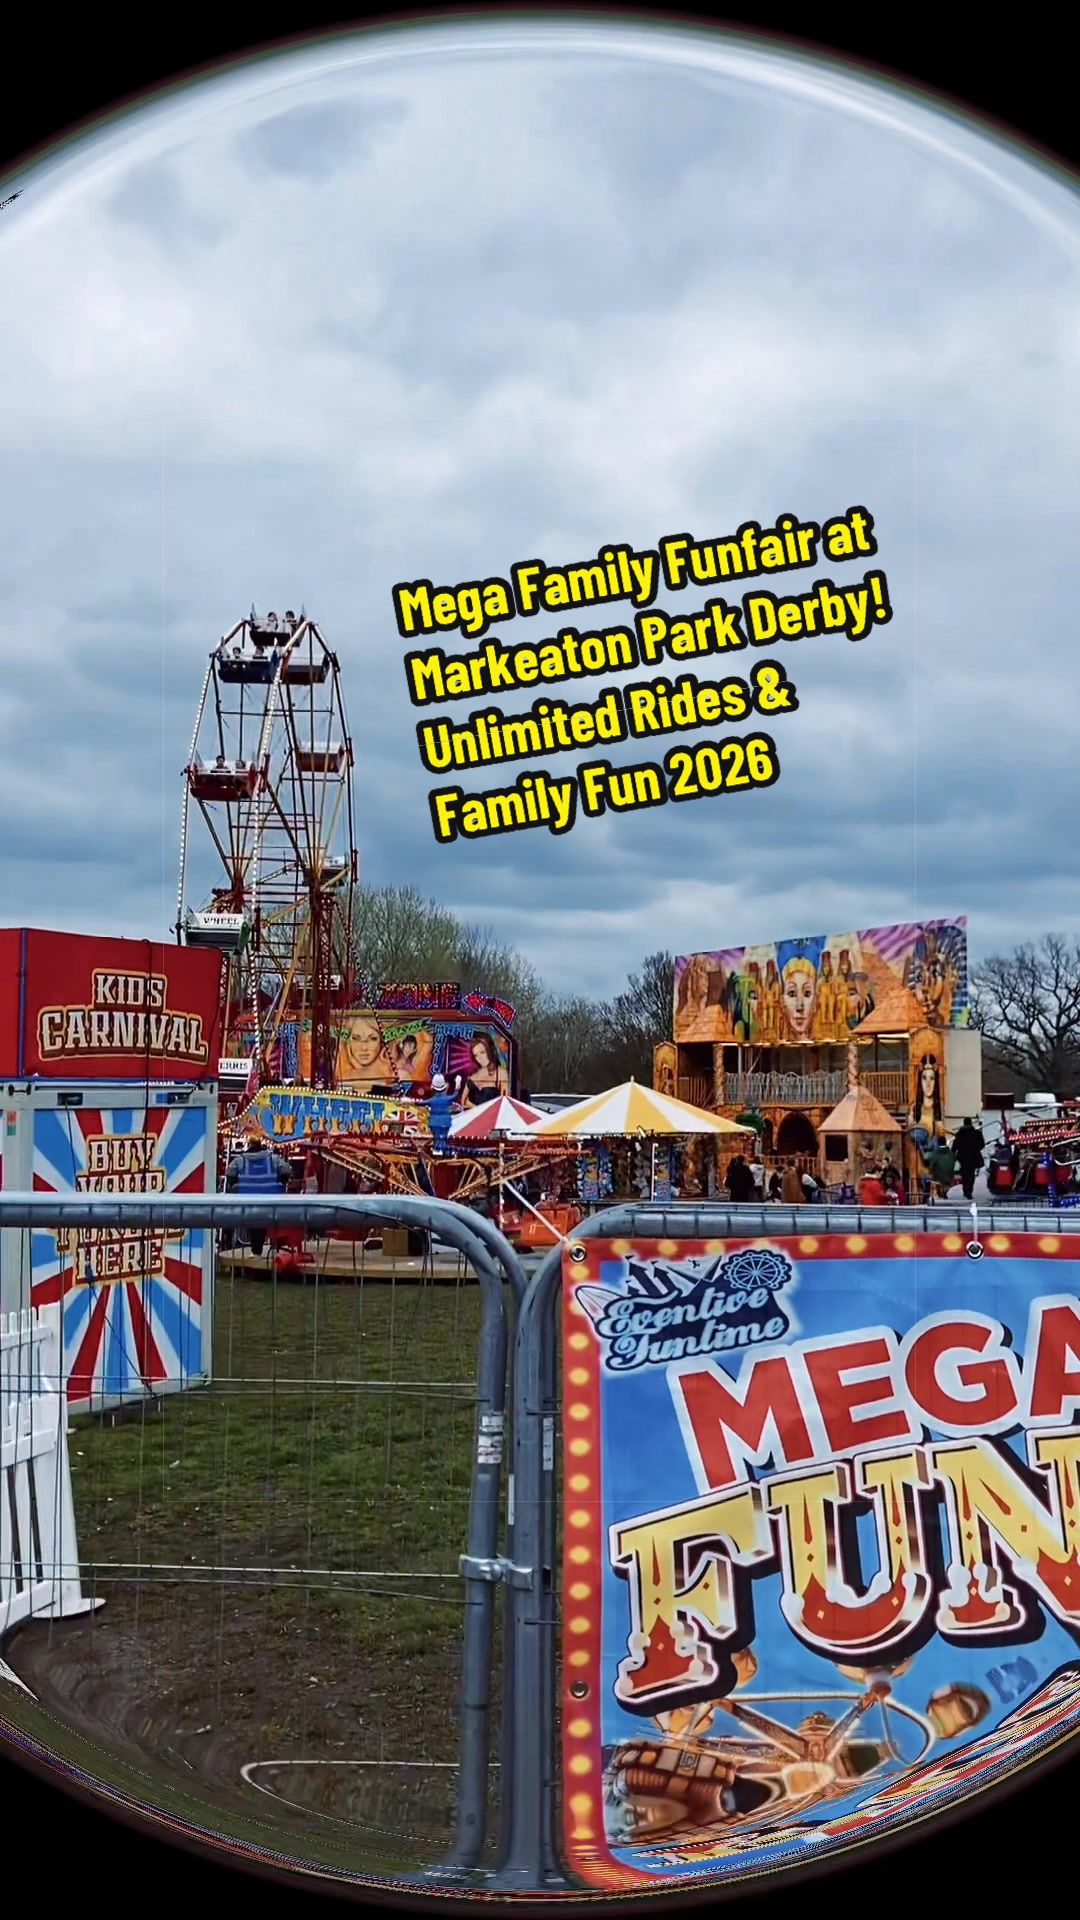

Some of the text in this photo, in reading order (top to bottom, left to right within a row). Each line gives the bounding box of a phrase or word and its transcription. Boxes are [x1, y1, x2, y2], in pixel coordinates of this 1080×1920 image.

[95, 973, 165, 1008] KIDS
[40, 1010, 207, 1059] CARNIVAL
[219, 1061, 248, 1071] ERRIS
[268, 1093, 389, 1136] WHEEL
[89, 1139, 155, 1174] BUY
[75, 1239, 163, 1281] HERE
[607, 1286, 780, 1338] Eventive
[615, 1316, 796, 1371] Funtime
